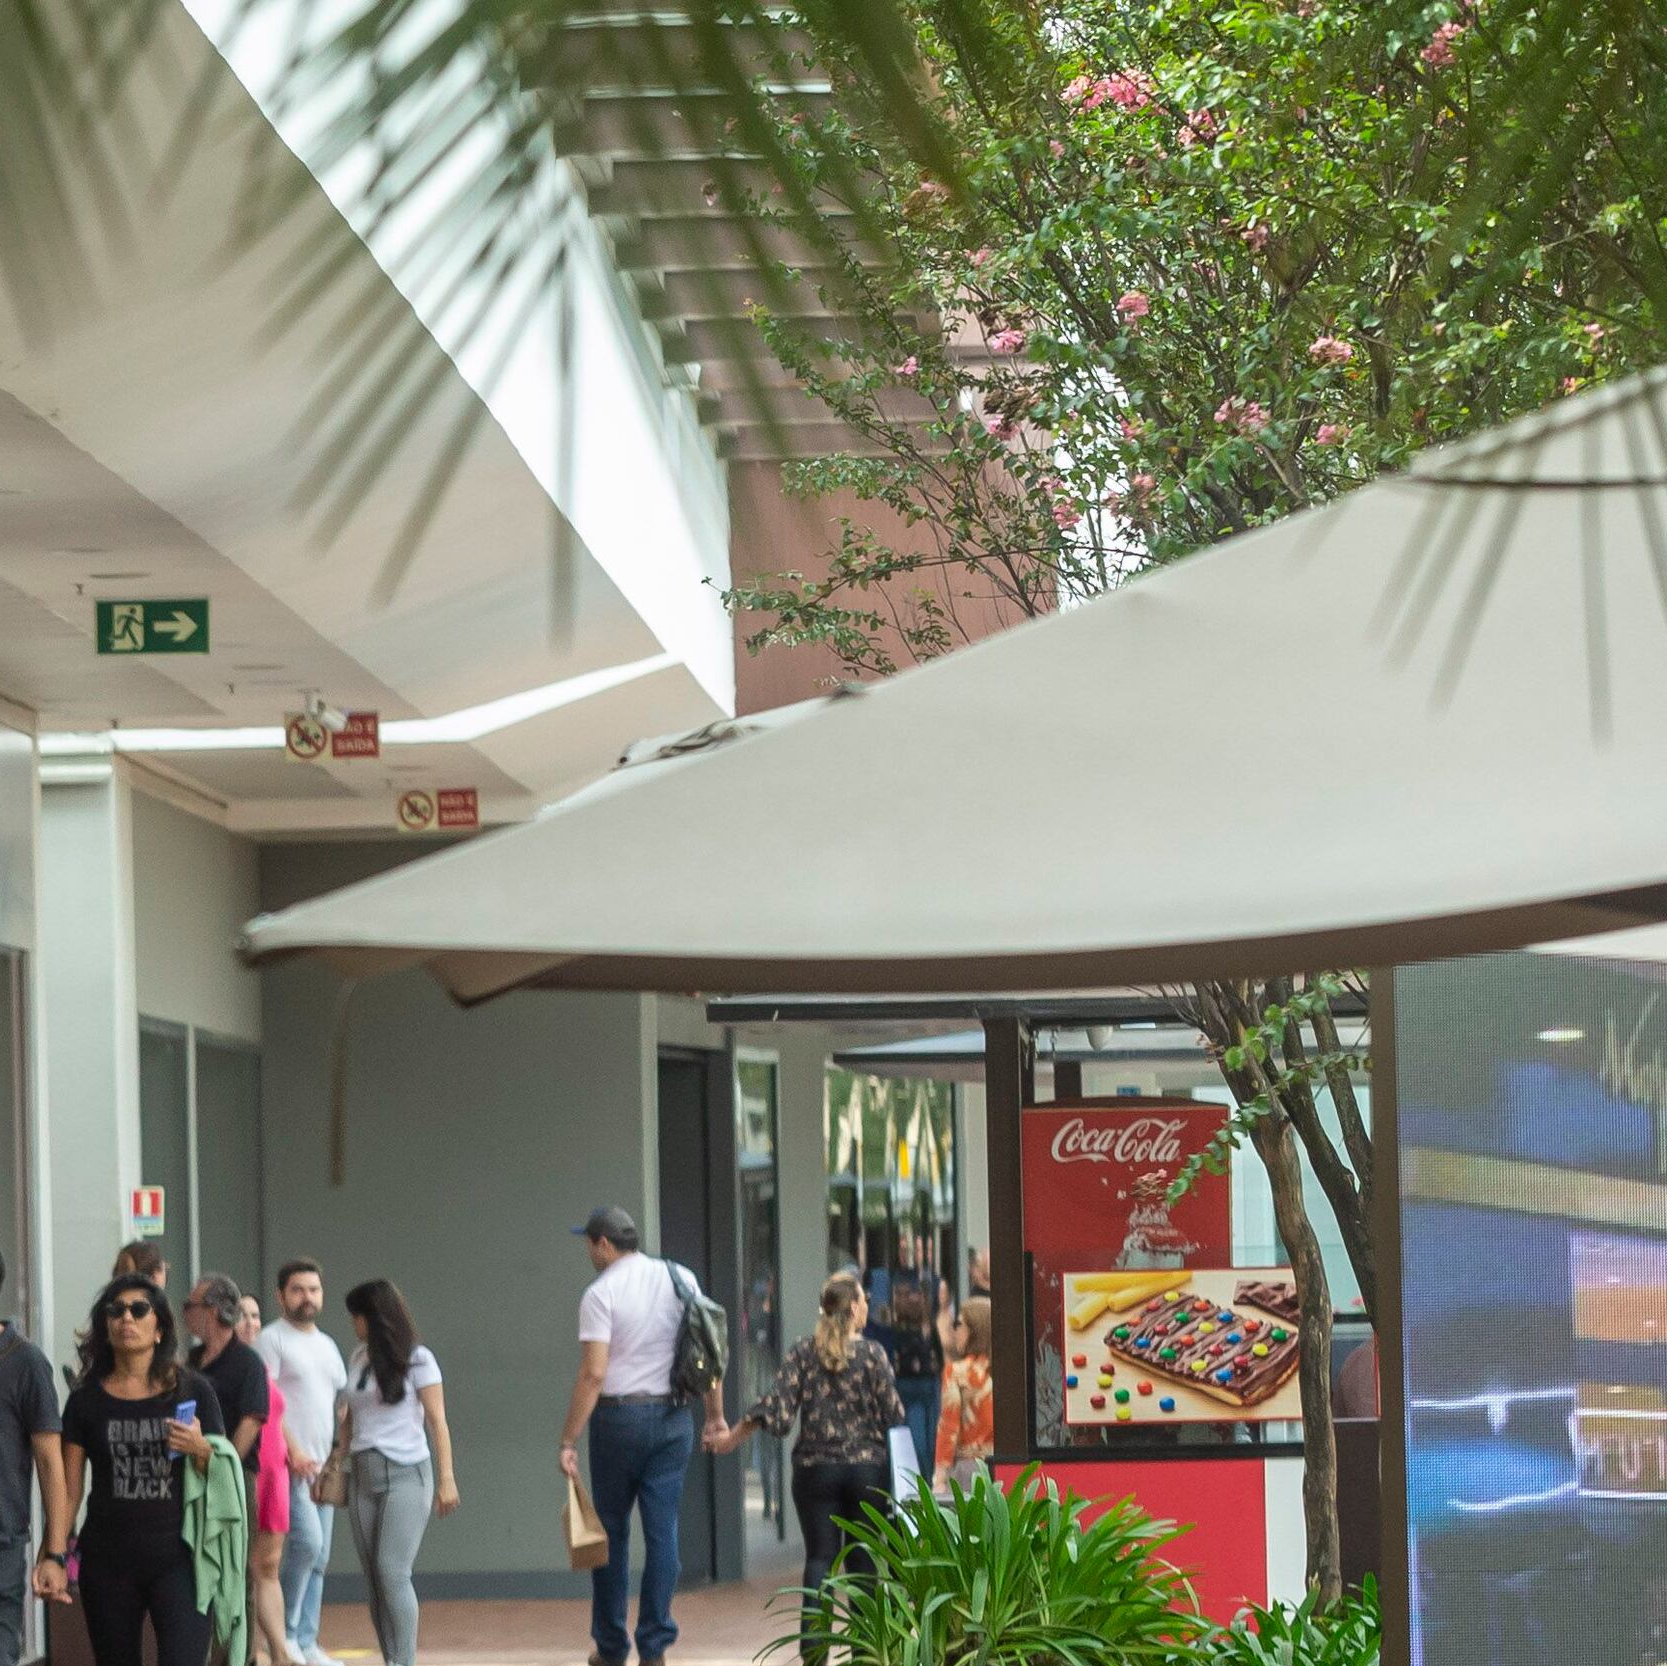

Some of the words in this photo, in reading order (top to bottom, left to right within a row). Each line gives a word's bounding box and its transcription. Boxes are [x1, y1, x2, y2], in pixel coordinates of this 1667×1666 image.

[1051, 1118, 1188, 1163] Coca-Cola
[112, 1455, 173, 1478] NEW
[112, 1476, 174, 1500] BLACK
